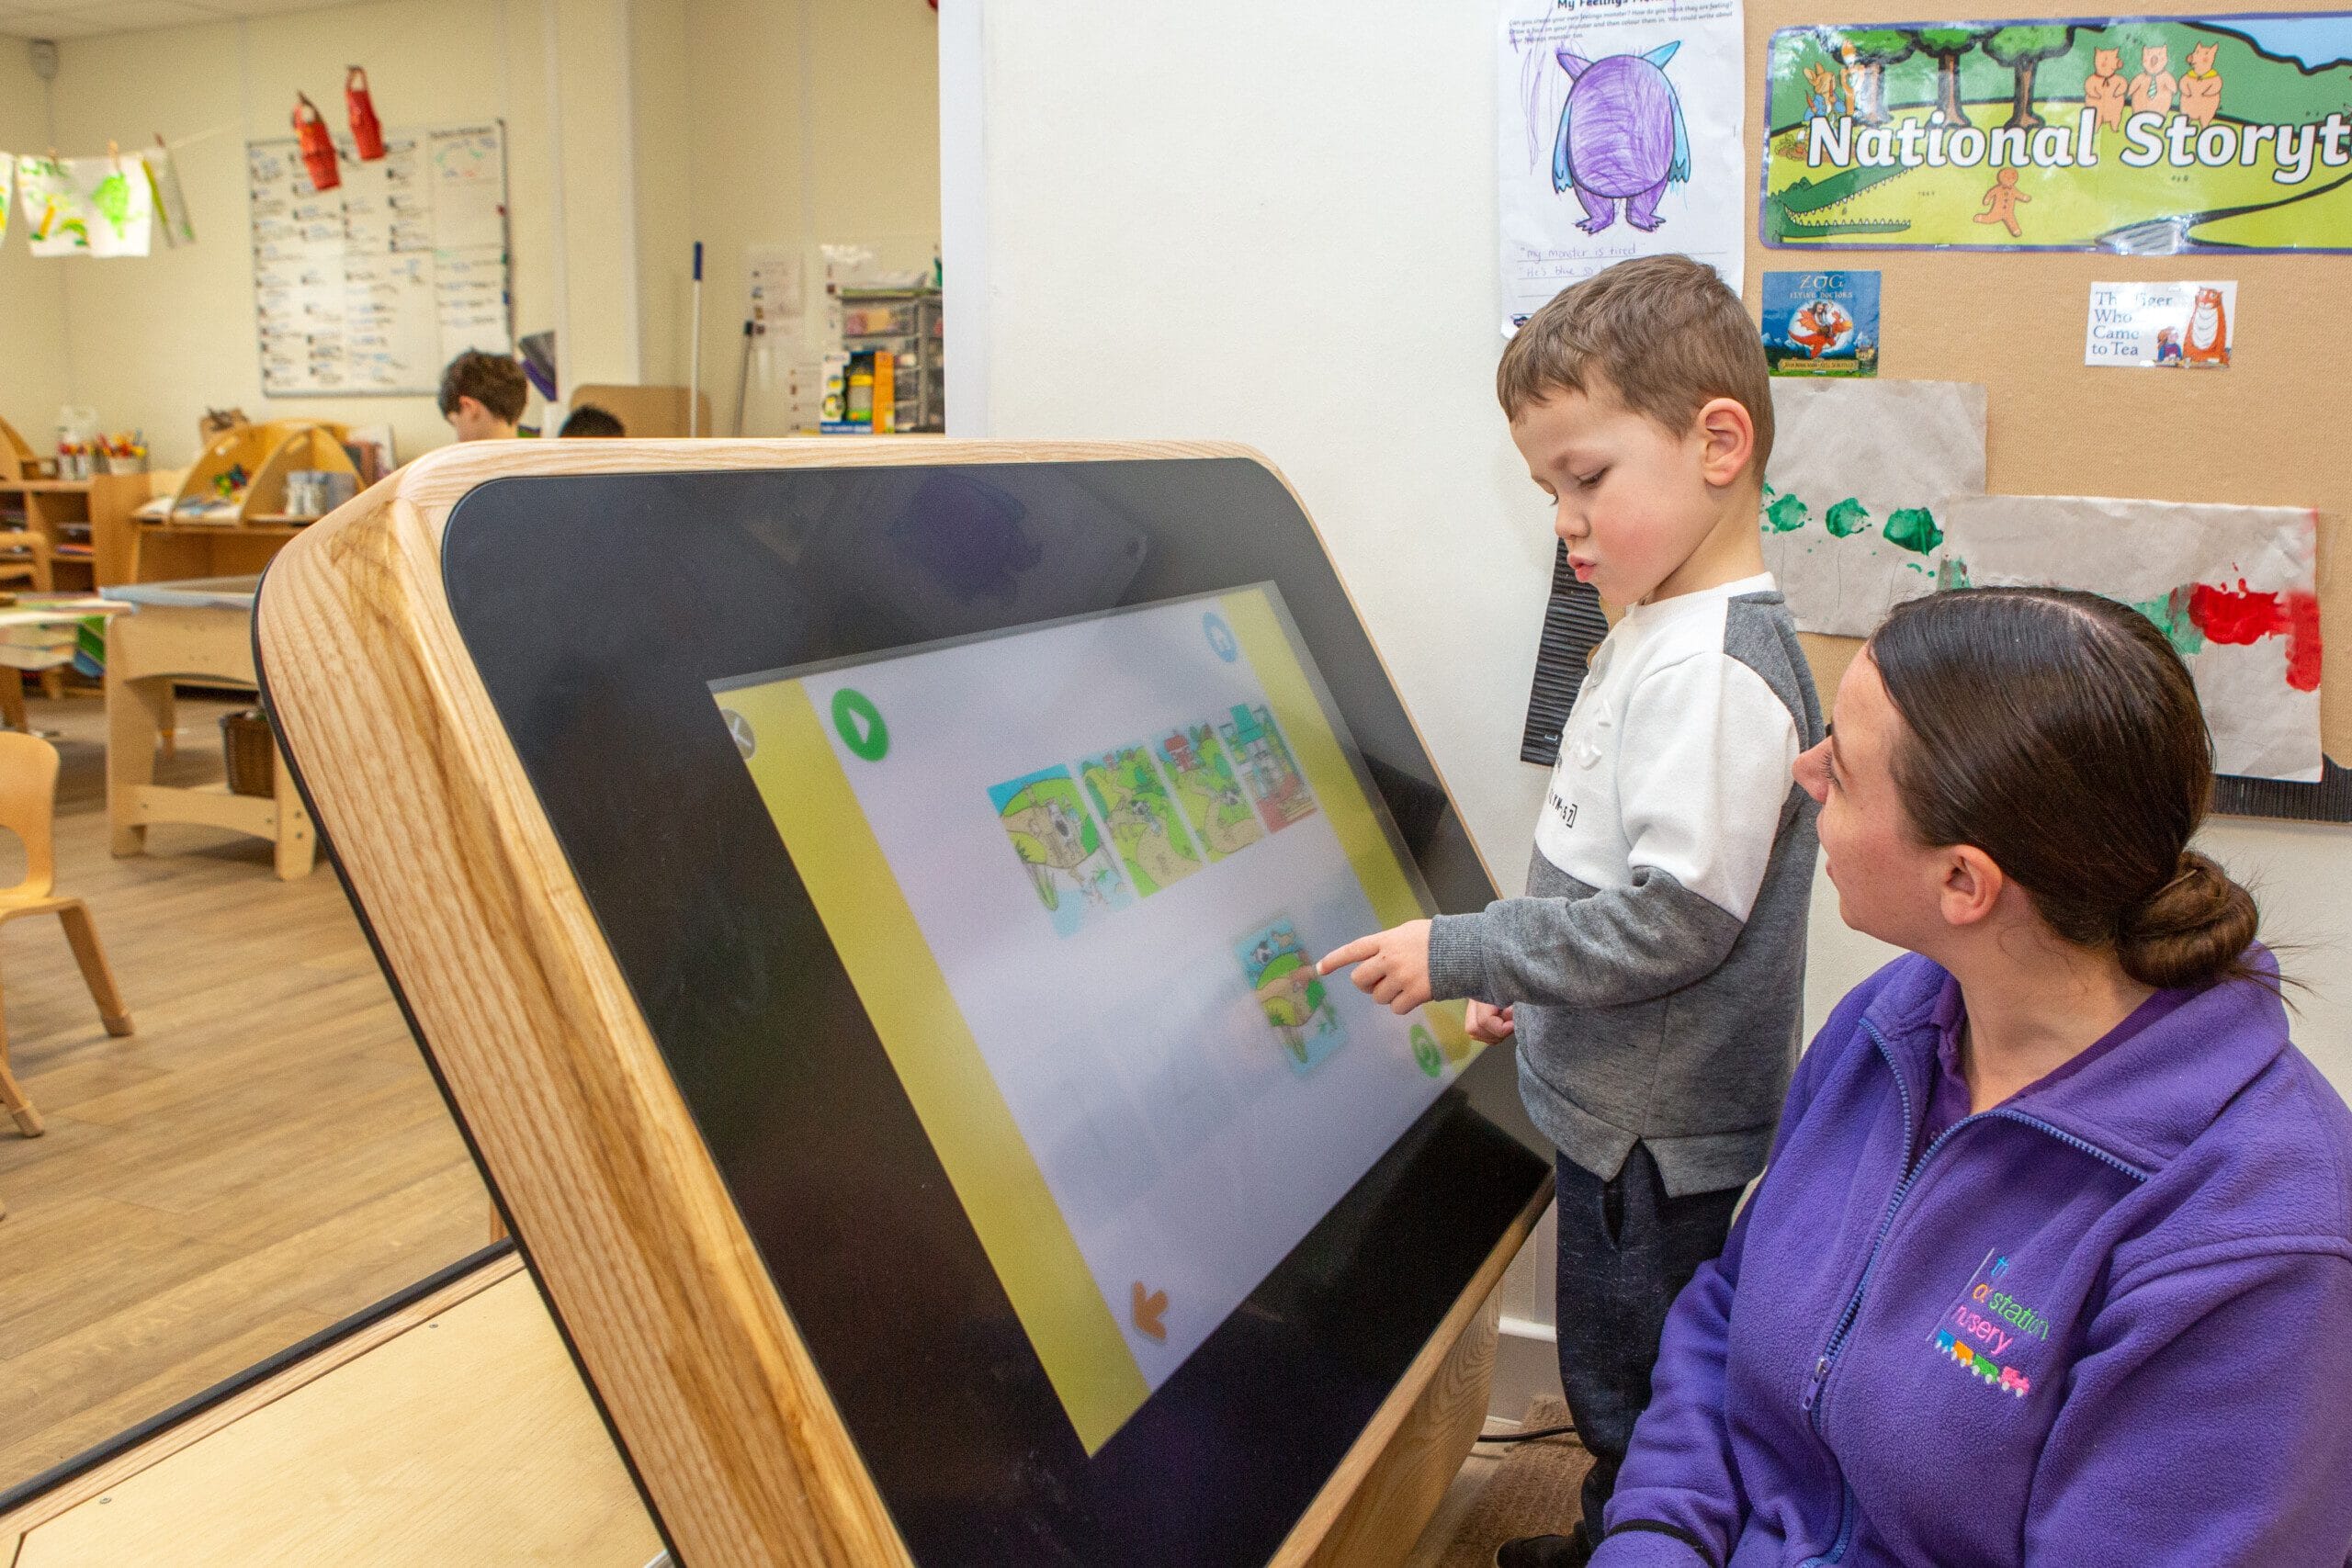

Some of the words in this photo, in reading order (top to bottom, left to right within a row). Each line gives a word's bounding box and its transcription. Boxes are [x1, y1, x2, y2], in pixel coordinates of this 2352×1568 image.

[1557, 0, 1575, 11] My
[1806, 106, 2099, 168] National
[2119, 109, 2352, 185] Storyt
[1595, 247, 1604, 257] is
[1799, 274, 1845, 289] ZOG
[2095, 291, 2118, 306] Th
[2135, 291, 2174, 308] iger
[2094, 309, 2132, 323] Who
[2093, 325, 2140, 340] Came
[2092, 344, 2108, 355] to
[2110, 342, 2139, 355] Tea
